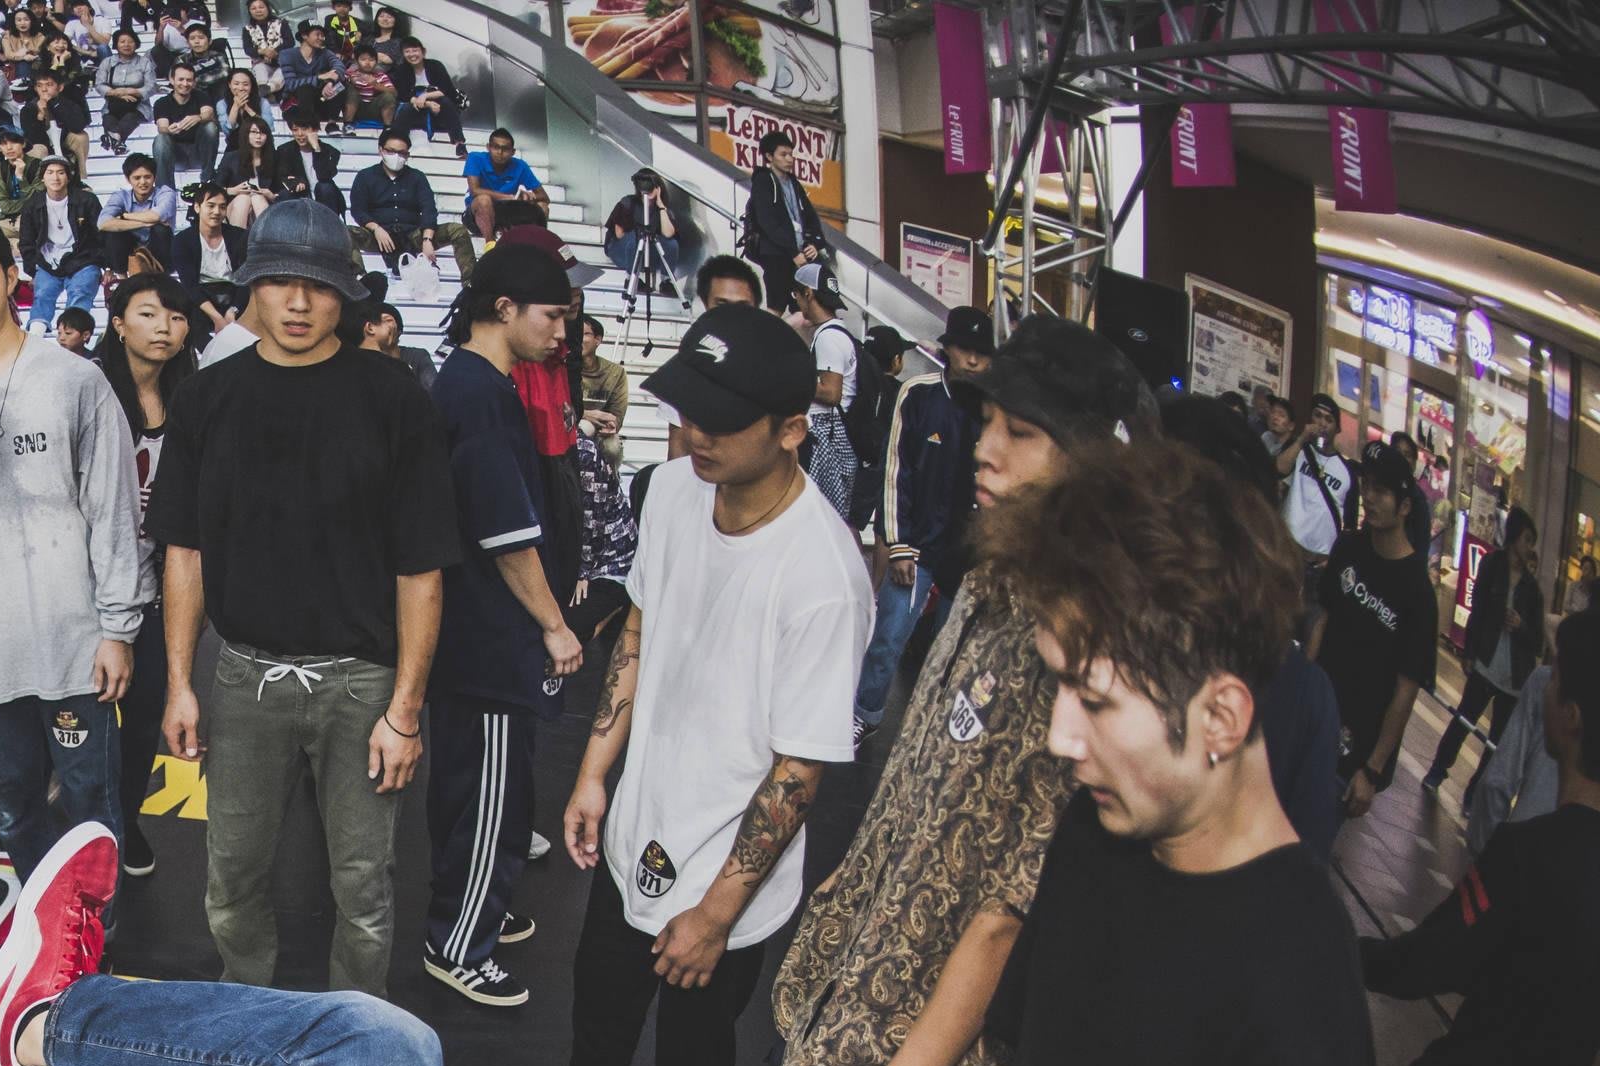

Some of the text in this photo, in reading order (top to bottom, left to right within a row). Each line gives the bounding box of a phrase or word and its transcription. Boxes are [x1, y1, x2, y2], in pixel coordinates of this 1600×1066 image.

[735, 142, 821, 184] KIEN
[1354, 582, 1399, 622] Cypher
[58, 730, 80, 745] 378
[952, 699, 976, 739] 369
[640, 867, 661, 894] 371
